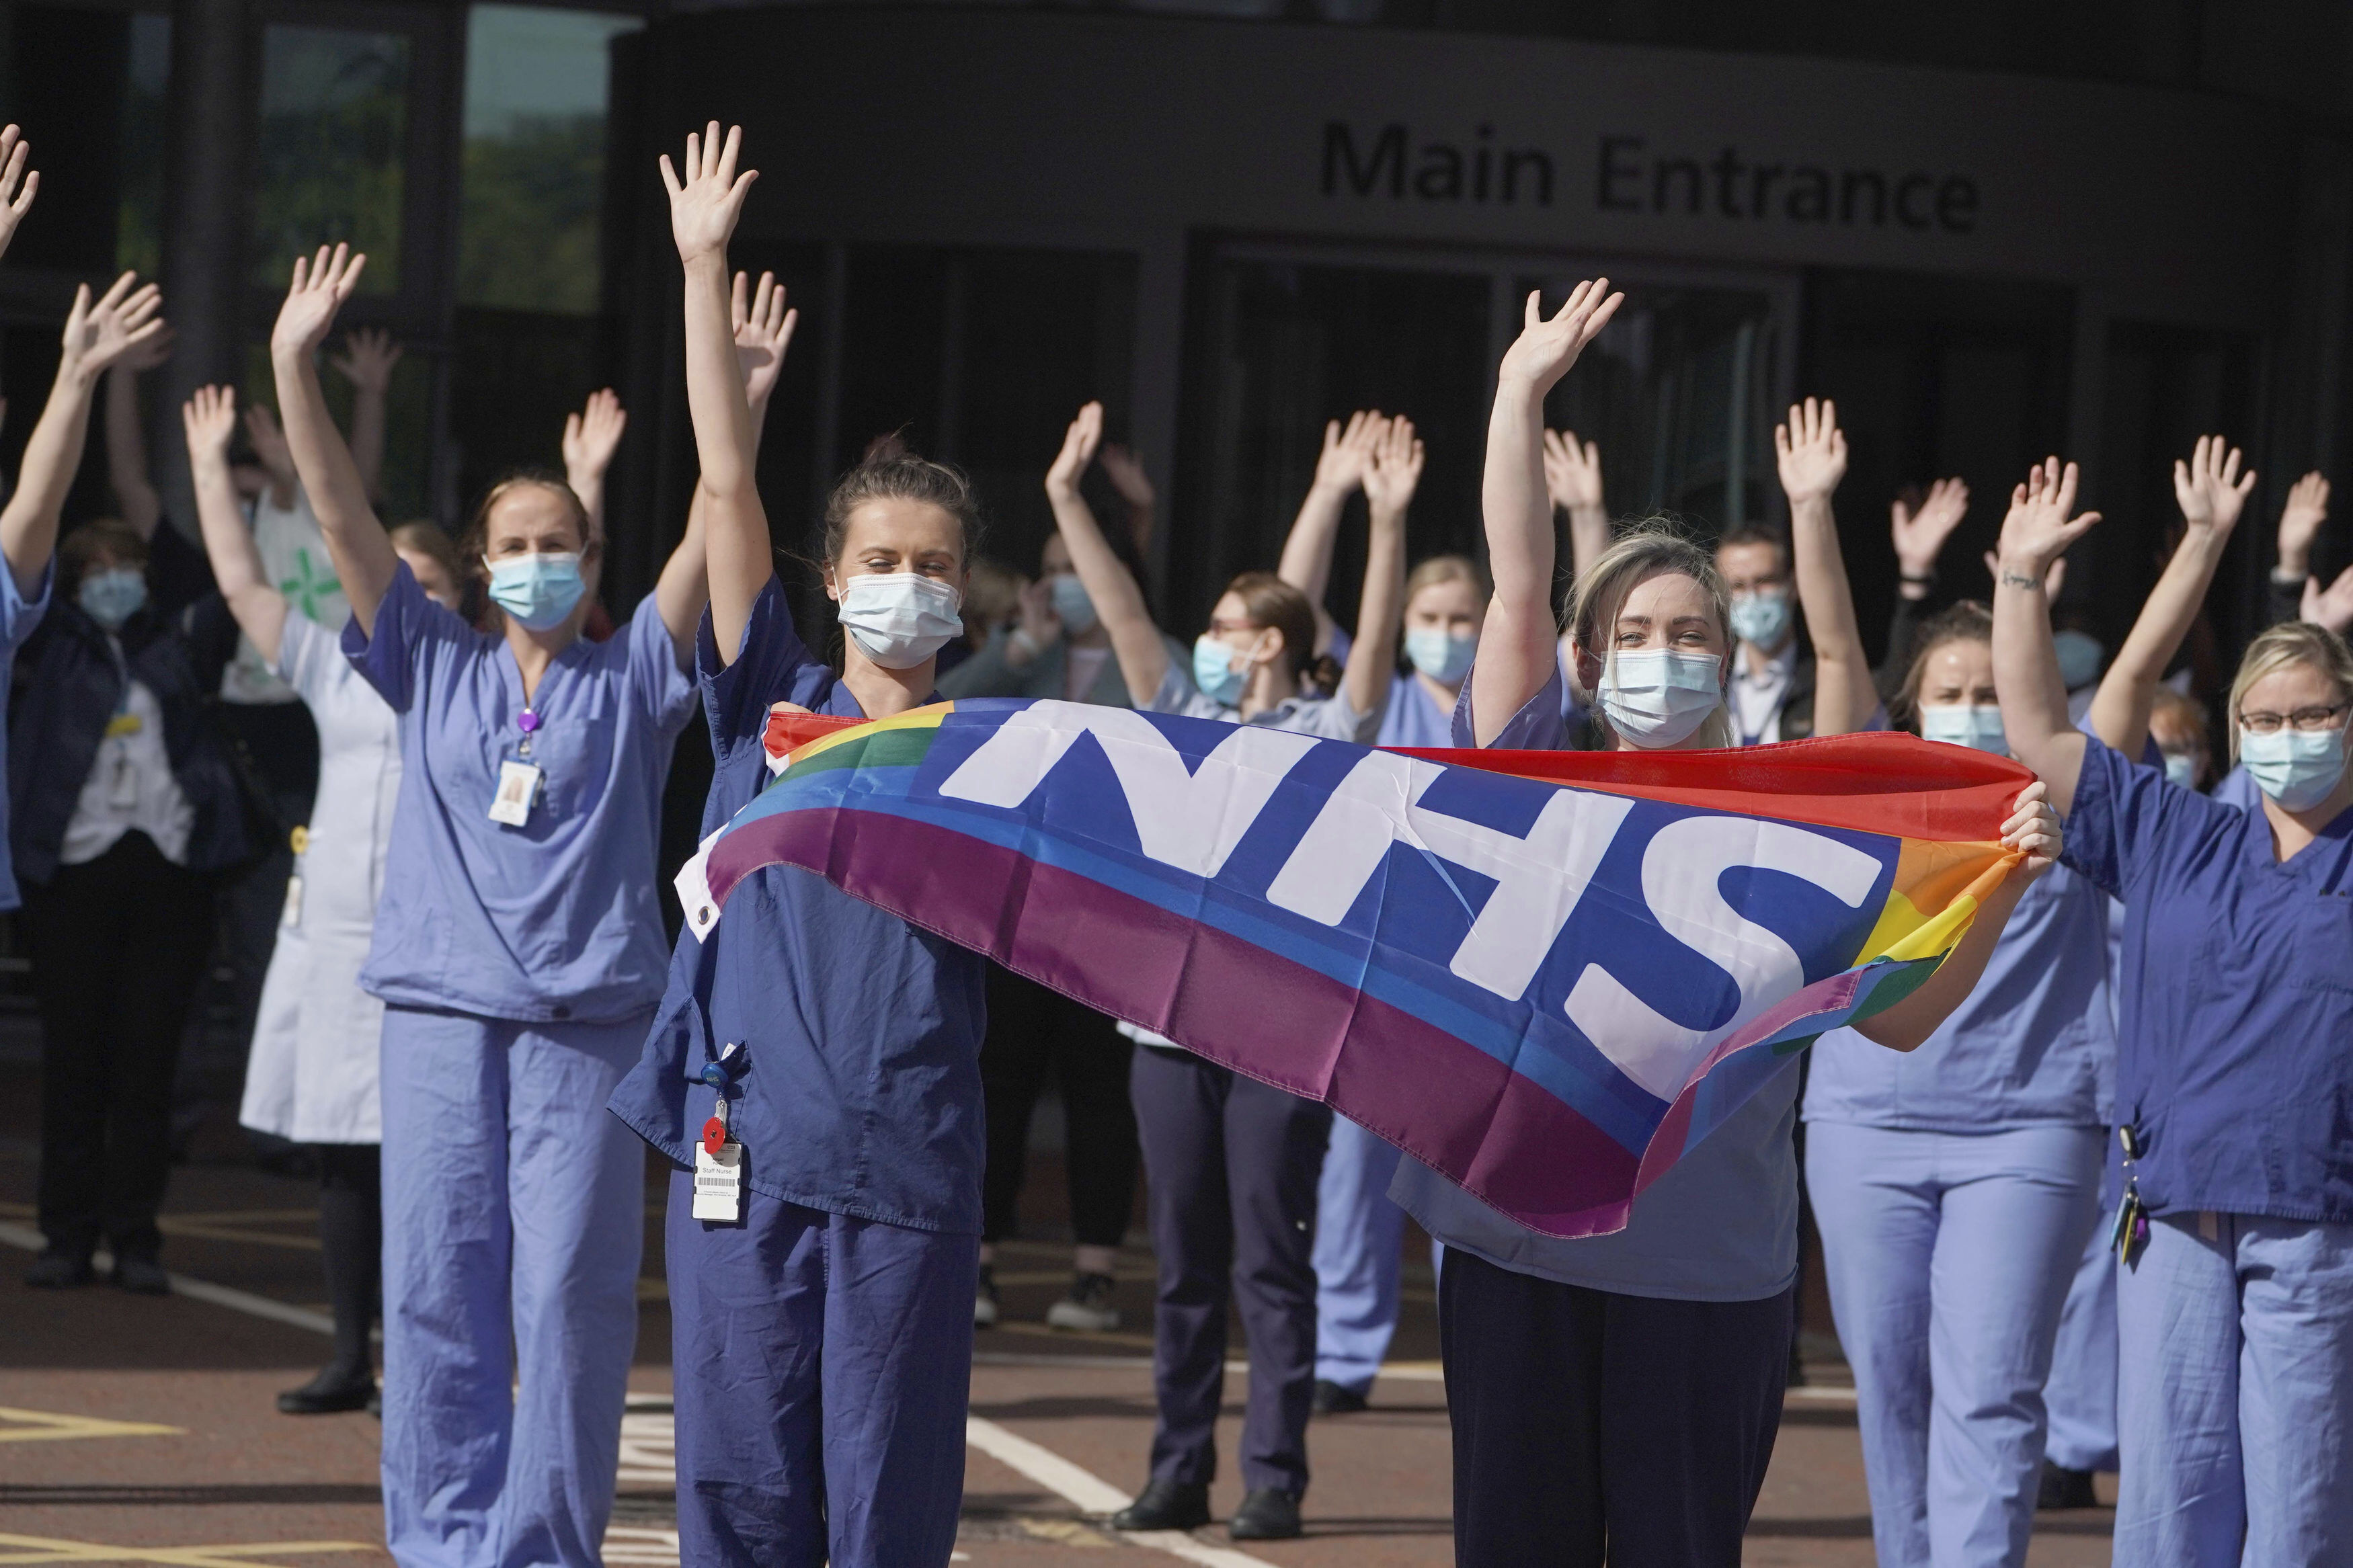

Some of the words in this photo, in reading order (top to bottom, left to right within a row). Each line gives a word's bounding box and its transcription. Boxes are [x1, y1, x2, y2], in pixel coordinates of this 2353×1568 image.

[1320, 120, 1556, 208] Main
[1595, 135, 1980, 234] Entrance
[939, 699, 1882, 1103] NHS
